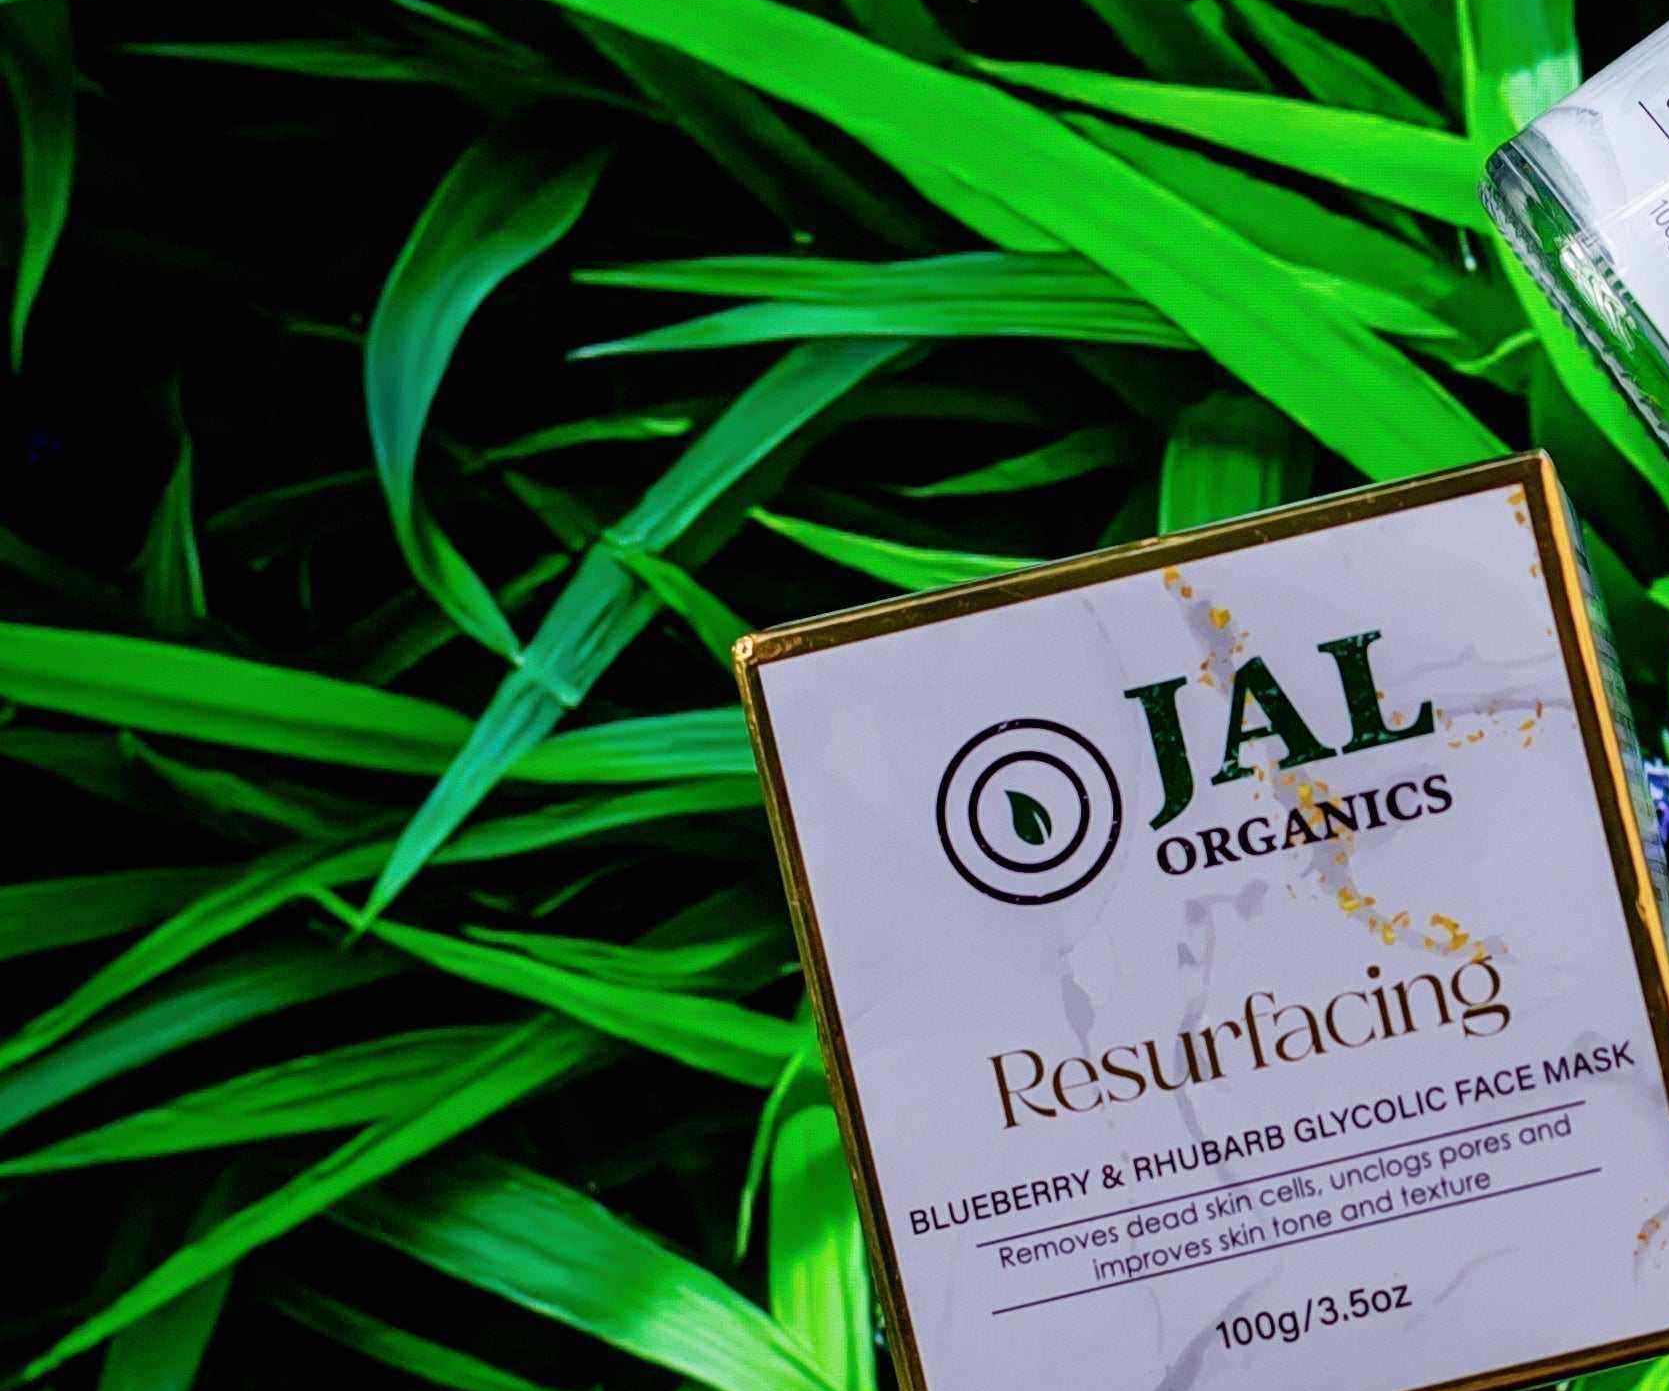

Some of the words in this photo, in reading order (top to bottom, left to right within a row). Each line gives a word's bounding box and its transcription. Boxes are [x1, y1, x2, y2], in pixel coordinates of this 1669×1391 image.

[1124, 630, 1437, 831] JAL
[1155, 772, 1454, 876] ORGANICS
[986, 955, 1512, 1130] Resurfacing
[908, 1169, 1092, 1235] BLUEBERRY
[1101, 1164, 1125, 1188] &
[1133, 1122, 1285, 1184] RHUBARB
[1292, 1085, 1448, 1145] GLYCOLIC
[1454, 1068, 1536, 1111] FACE
[1542, 1041, 1635, 1090] MASK
[998, 1224, 1120, 1268] Removes
[1126, 1202, 1199, 1240] dead
[1205, 1188, 1253, 1223] skin
[1258, 1174, 1325, 1211] cells,
[1328, 1150, 1432, 1194] unclogs
[1438, 1133, 1512, 1172] pores
[1518, 1114, 1572, 1149] and
[1091, 1238, 1214, 1281] improves
[1219, 1219, 1267, 1252] skin
[1272, 1206, 1333, 1242] tone
[1339, 1188, 1393, 1225] and
[1399, 1169, 1491, 1212] texture
[1214, 1281, 1412, 1352] 100g/3.5oz
